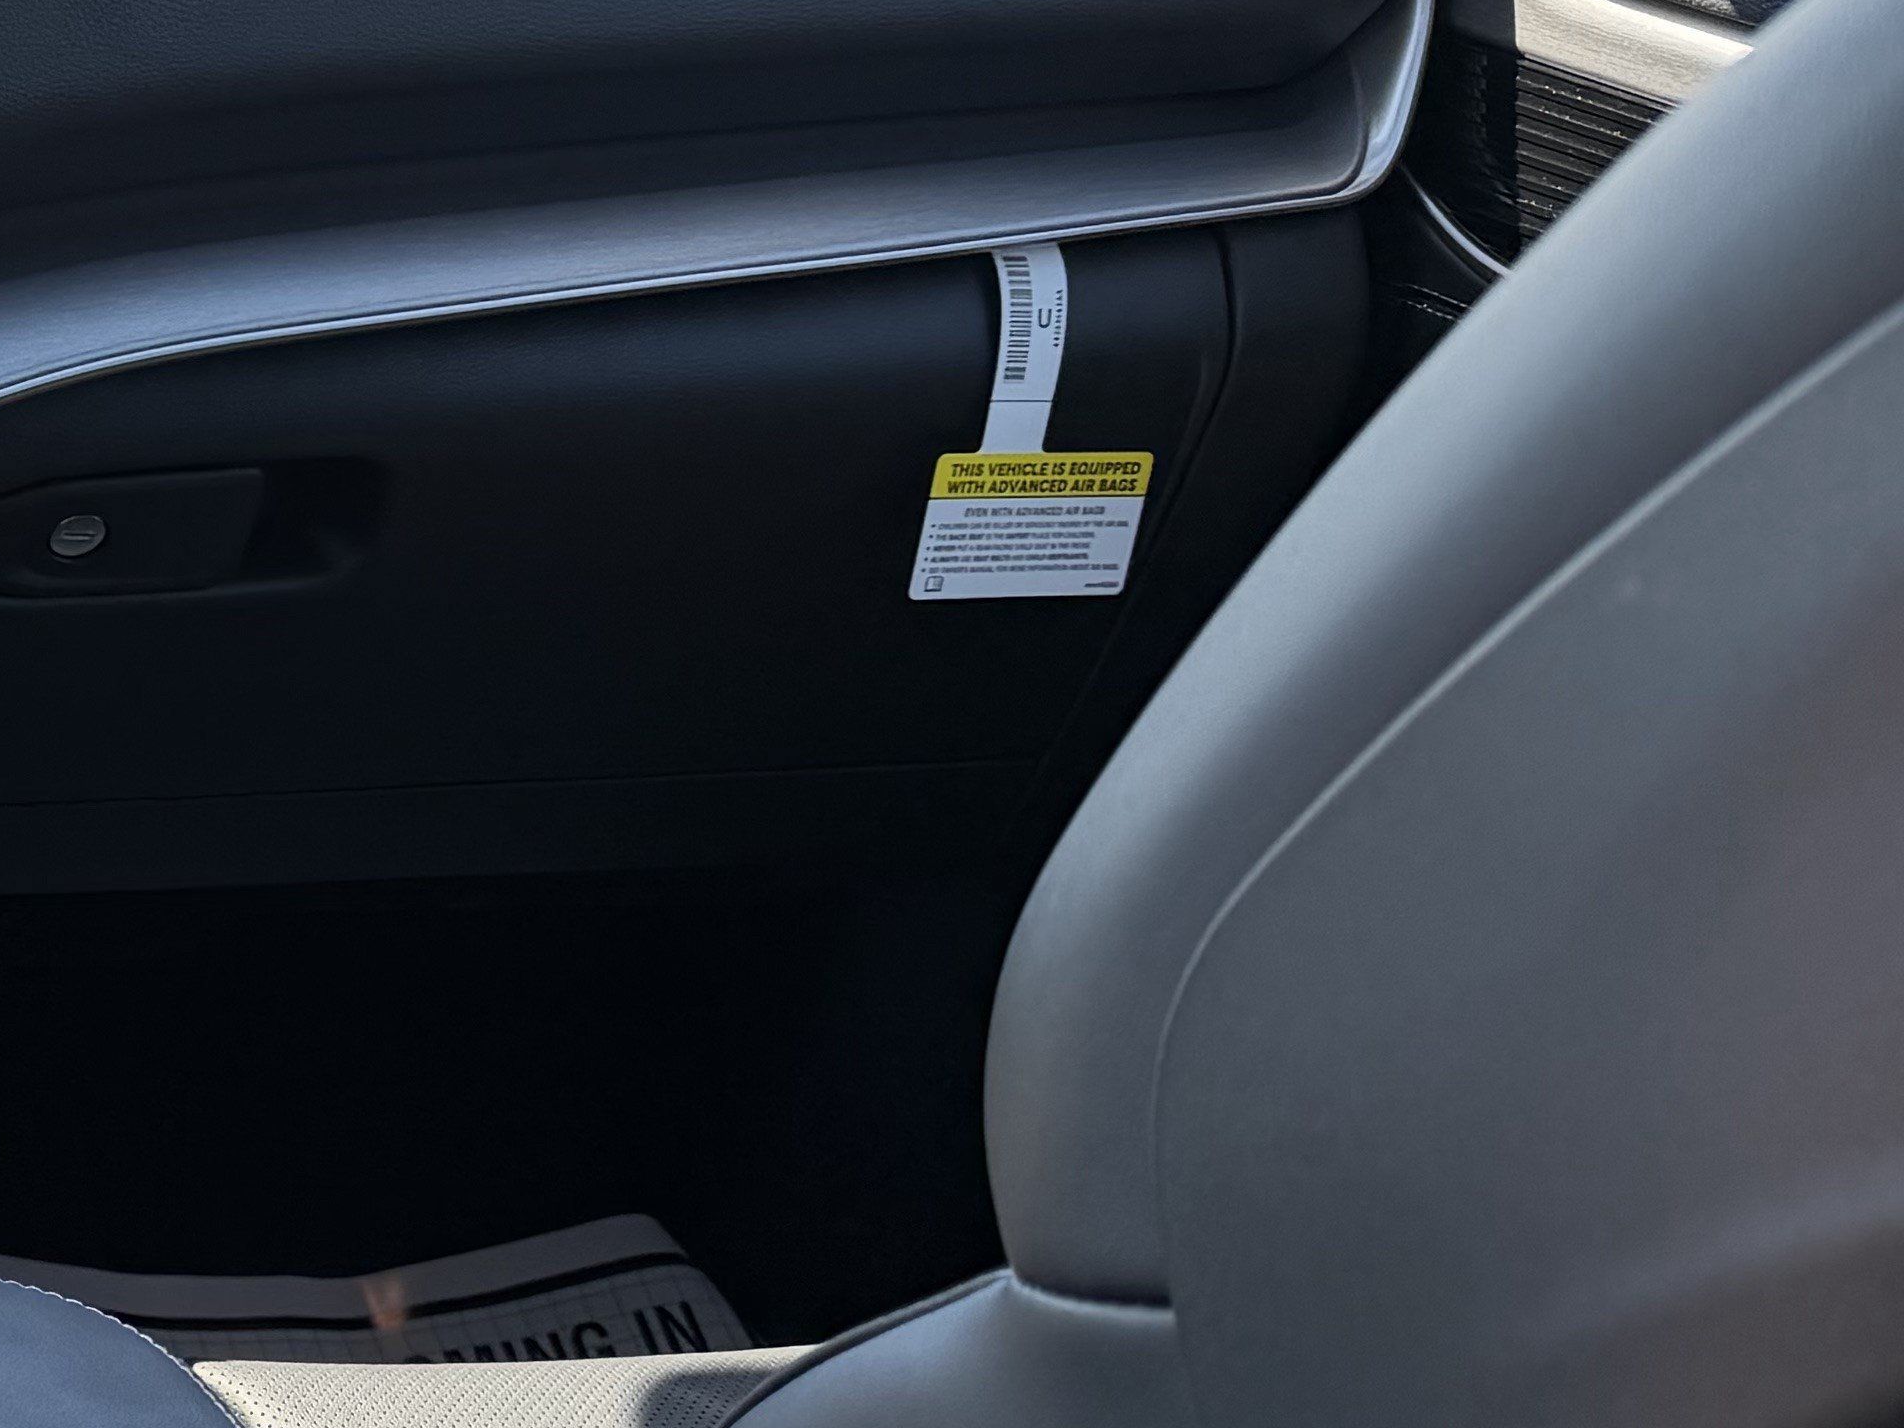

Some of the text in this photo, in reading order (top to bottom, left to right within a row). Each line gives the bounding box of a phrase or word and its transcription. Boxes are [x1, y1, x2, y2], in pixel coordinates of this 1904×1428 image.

[951, 461, 1141, 477] THIS VEHICLE IS EQUIPPED
[947, 478, 1138, 494] WITH ADVANCED AIR BAGS
[634, 1299, 710, 1354] IN
